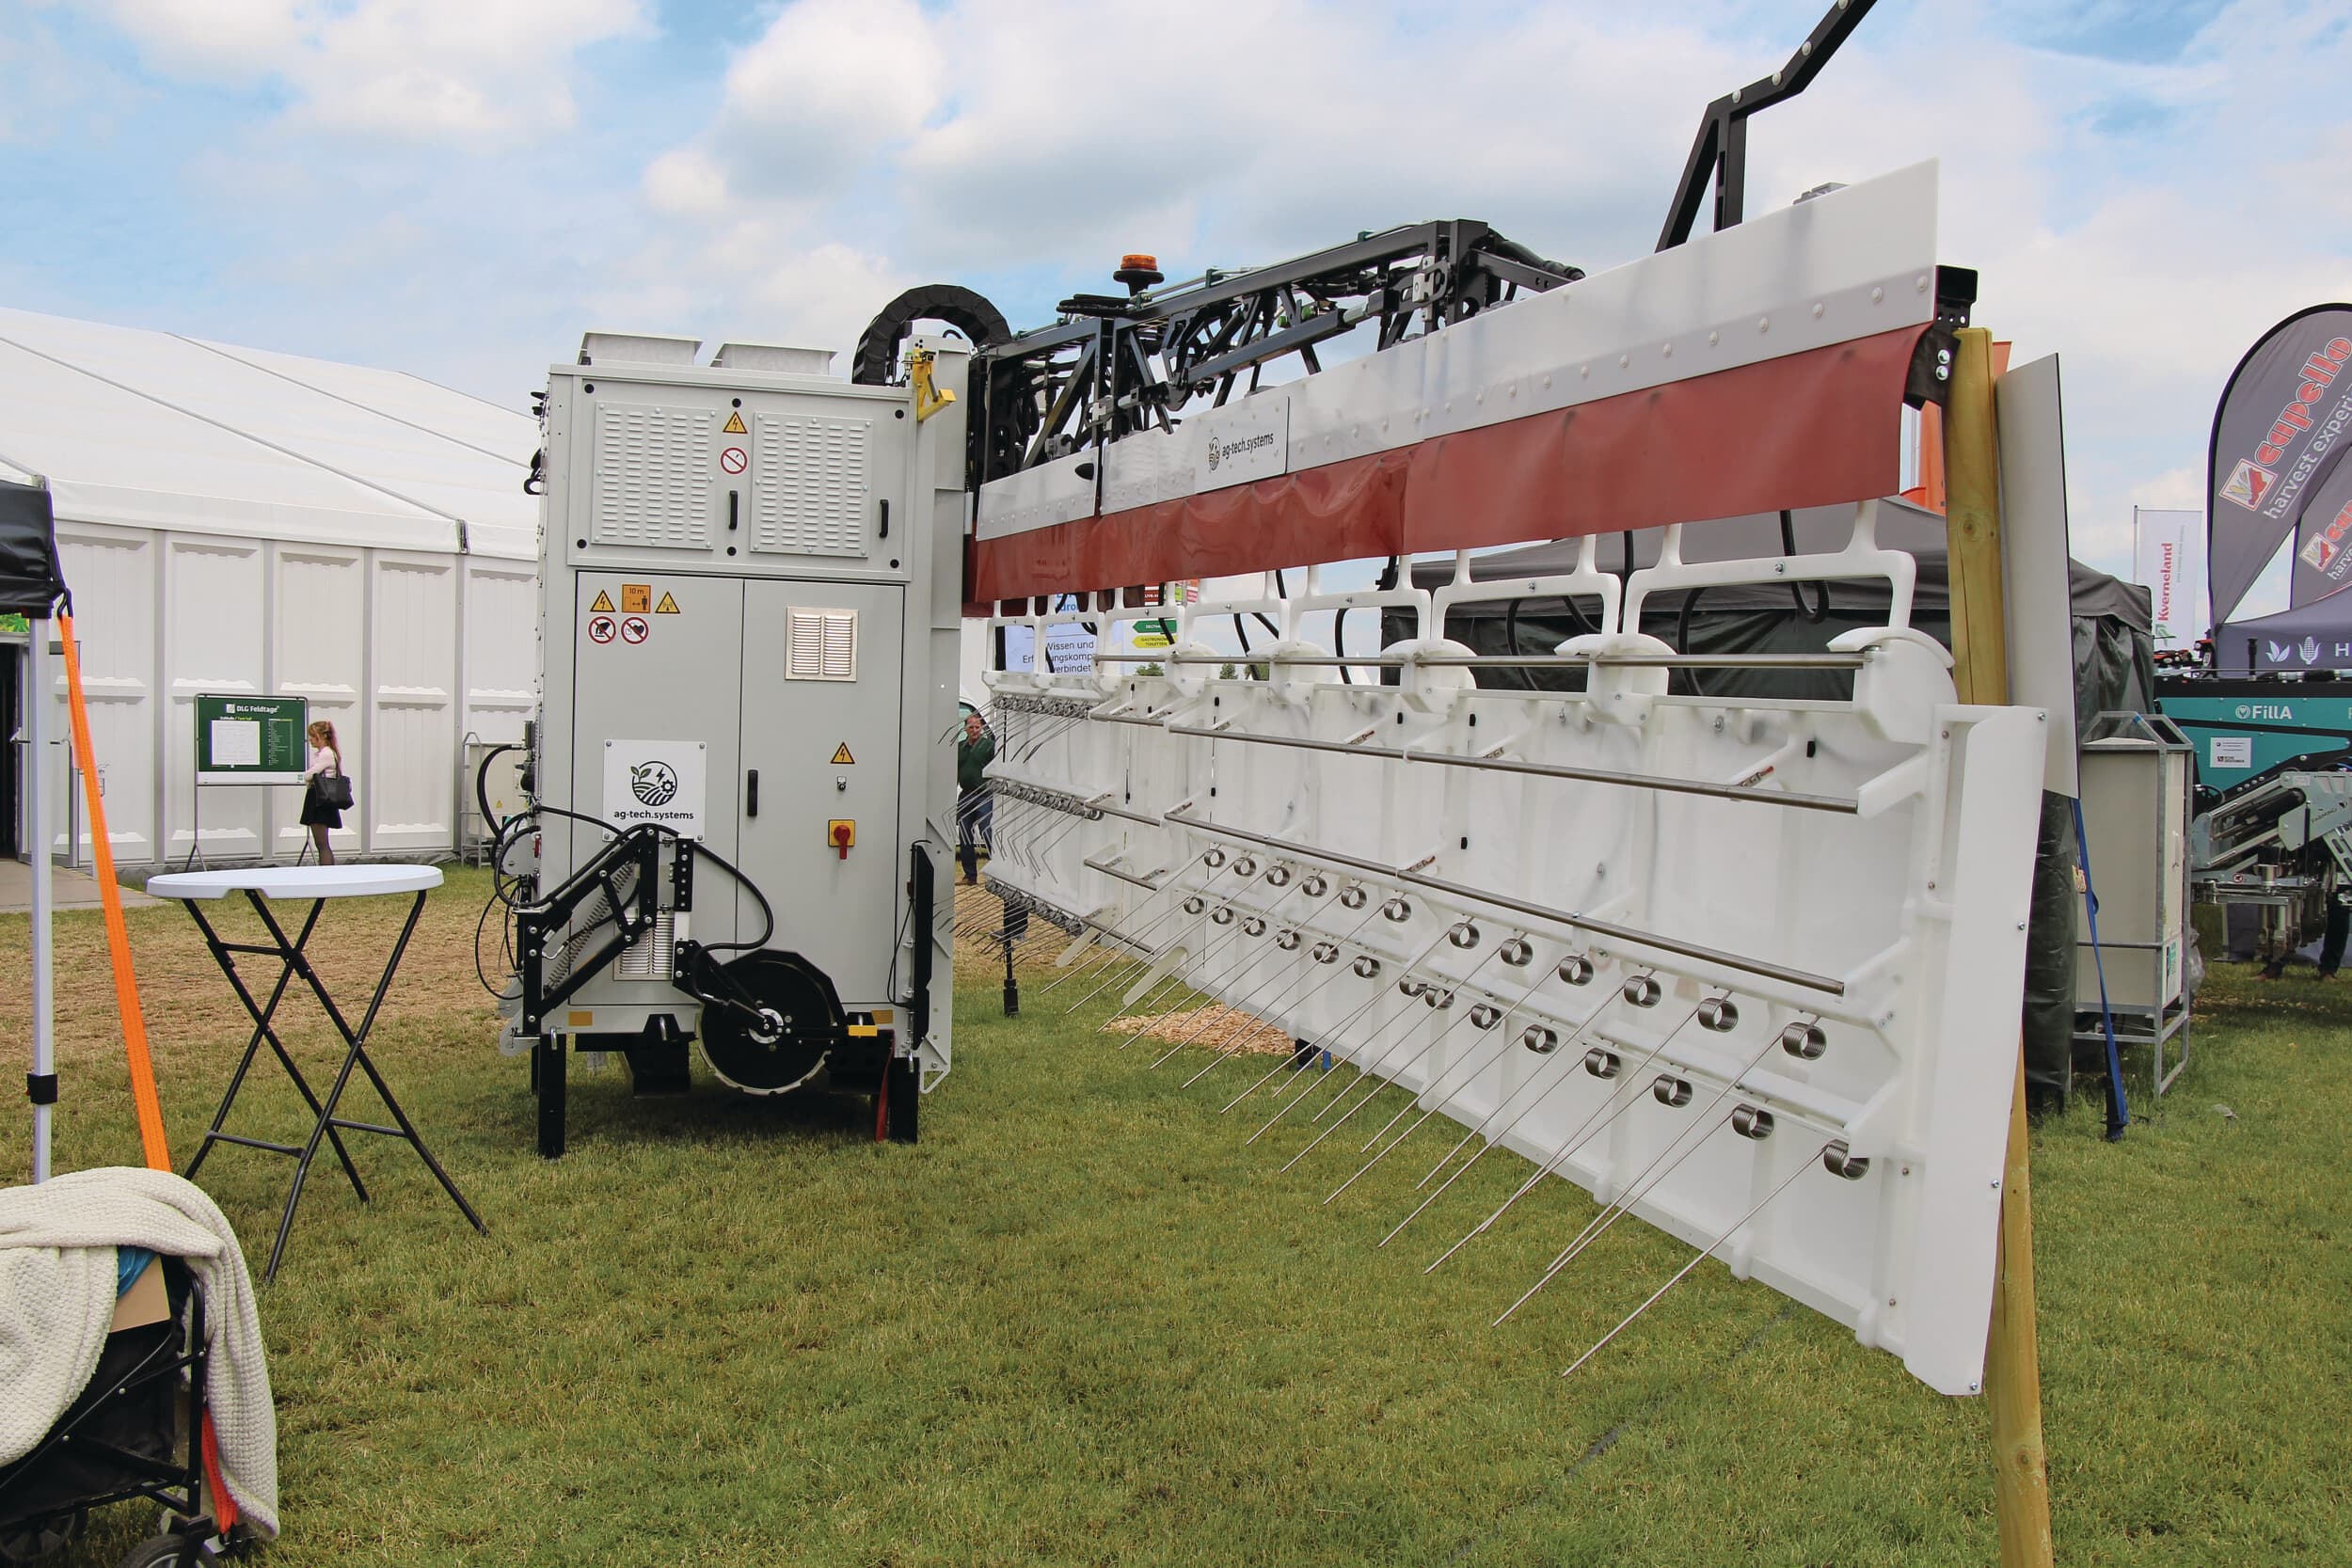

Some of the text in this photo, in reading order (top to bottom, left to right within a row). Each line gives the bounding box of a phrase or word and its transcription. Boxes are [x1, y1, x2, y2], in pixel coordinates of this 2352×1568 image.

[1222, 433, 1274, 460] ag-tech.systems
[2263, 453, 2318, 519] harvest
[2312, 390, 2352, 452] experi
[2157, 543, 2172, 621] Kverneland
[1077, 641, 1094, 649] und
[249, 705, 278, 714] Feldtage
[2252, 705, 2293, 720] FillA
[613, 809, 694, 821] ag-tech.systems
